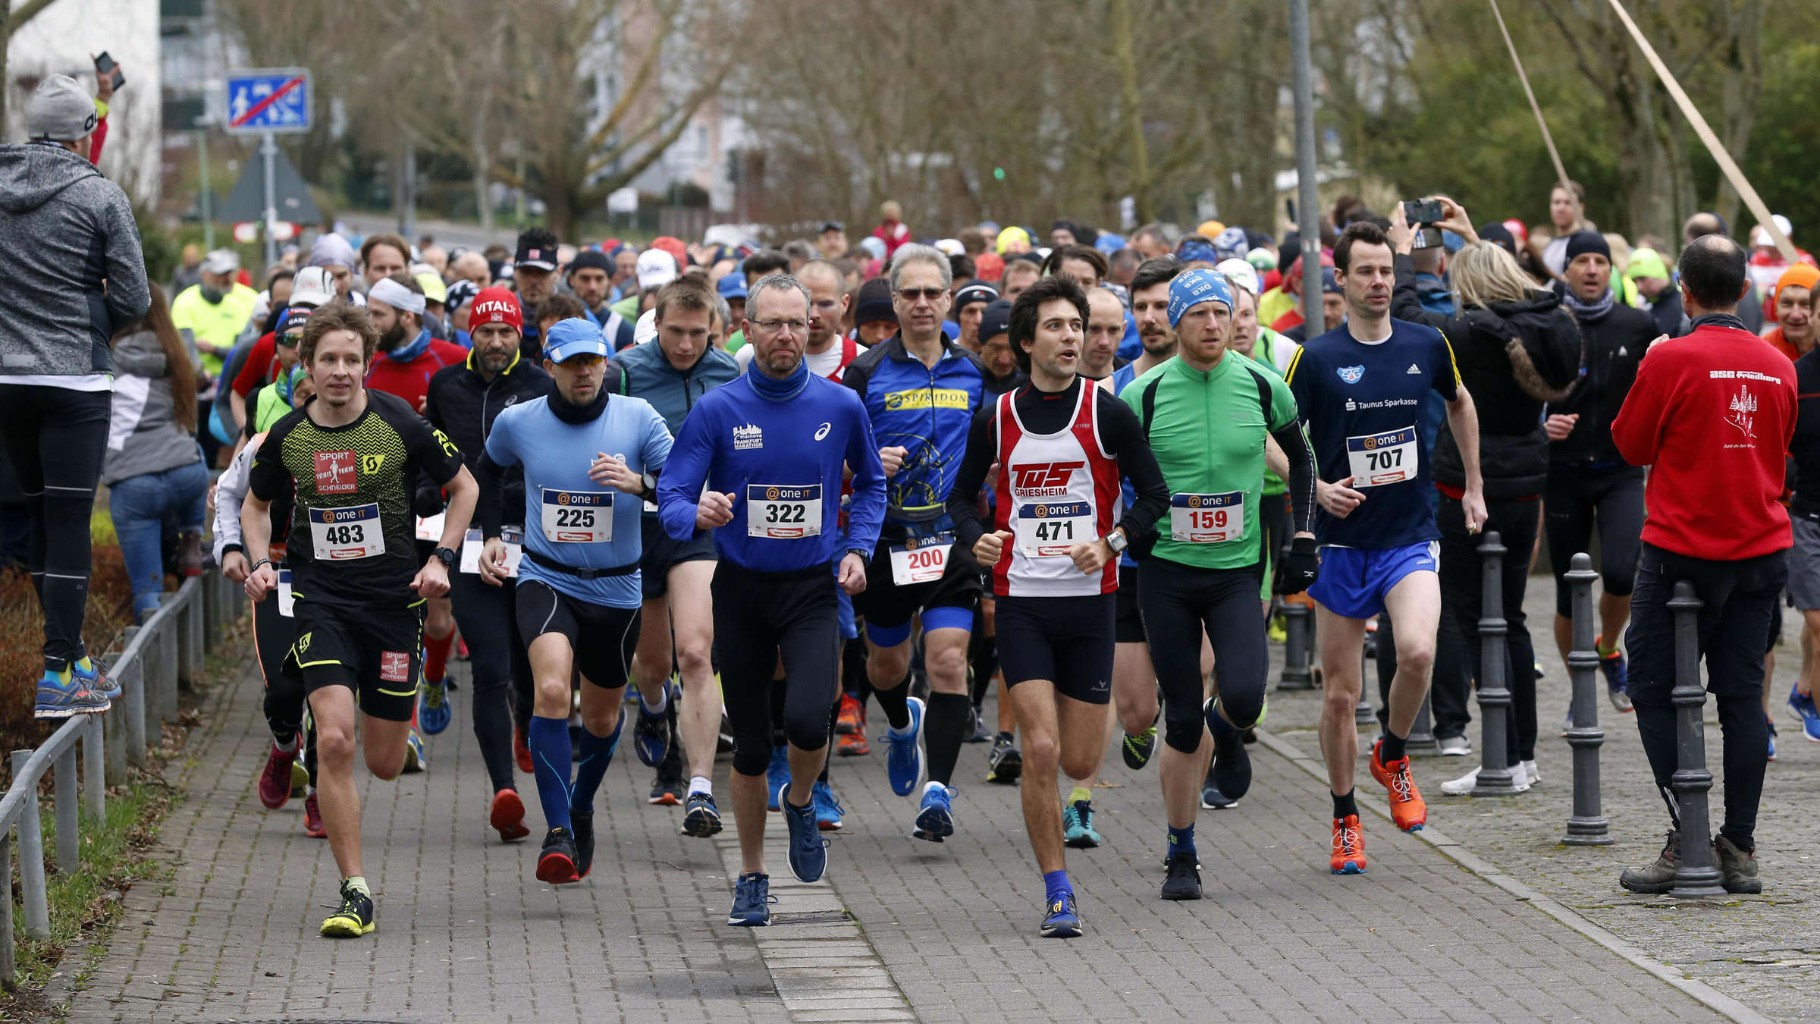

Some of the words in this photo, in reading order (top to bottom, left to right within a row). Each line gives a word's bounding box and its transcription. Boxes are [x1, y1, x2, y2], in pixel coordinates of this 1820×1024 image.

[904, 393, 966, 403] SPIRIDON
[1359, 401, 1383, 410] Taunus
[1384, 398, 1418, 408] Sparkasse
[320, 452, 349, 460] SPORT
[1366, 448, 1402, 471] 707
[1015, 488, 1067, 497] GRIESHEIM
[557, 509, 595, 528] 225
[766, 504, 805, 523] 322
[1189, 510, 1228, 528] 159
[326, 524, 365, 544] 483
[1036, 520, 1073, 540] 471
[908, 549, 943, 569] 200
